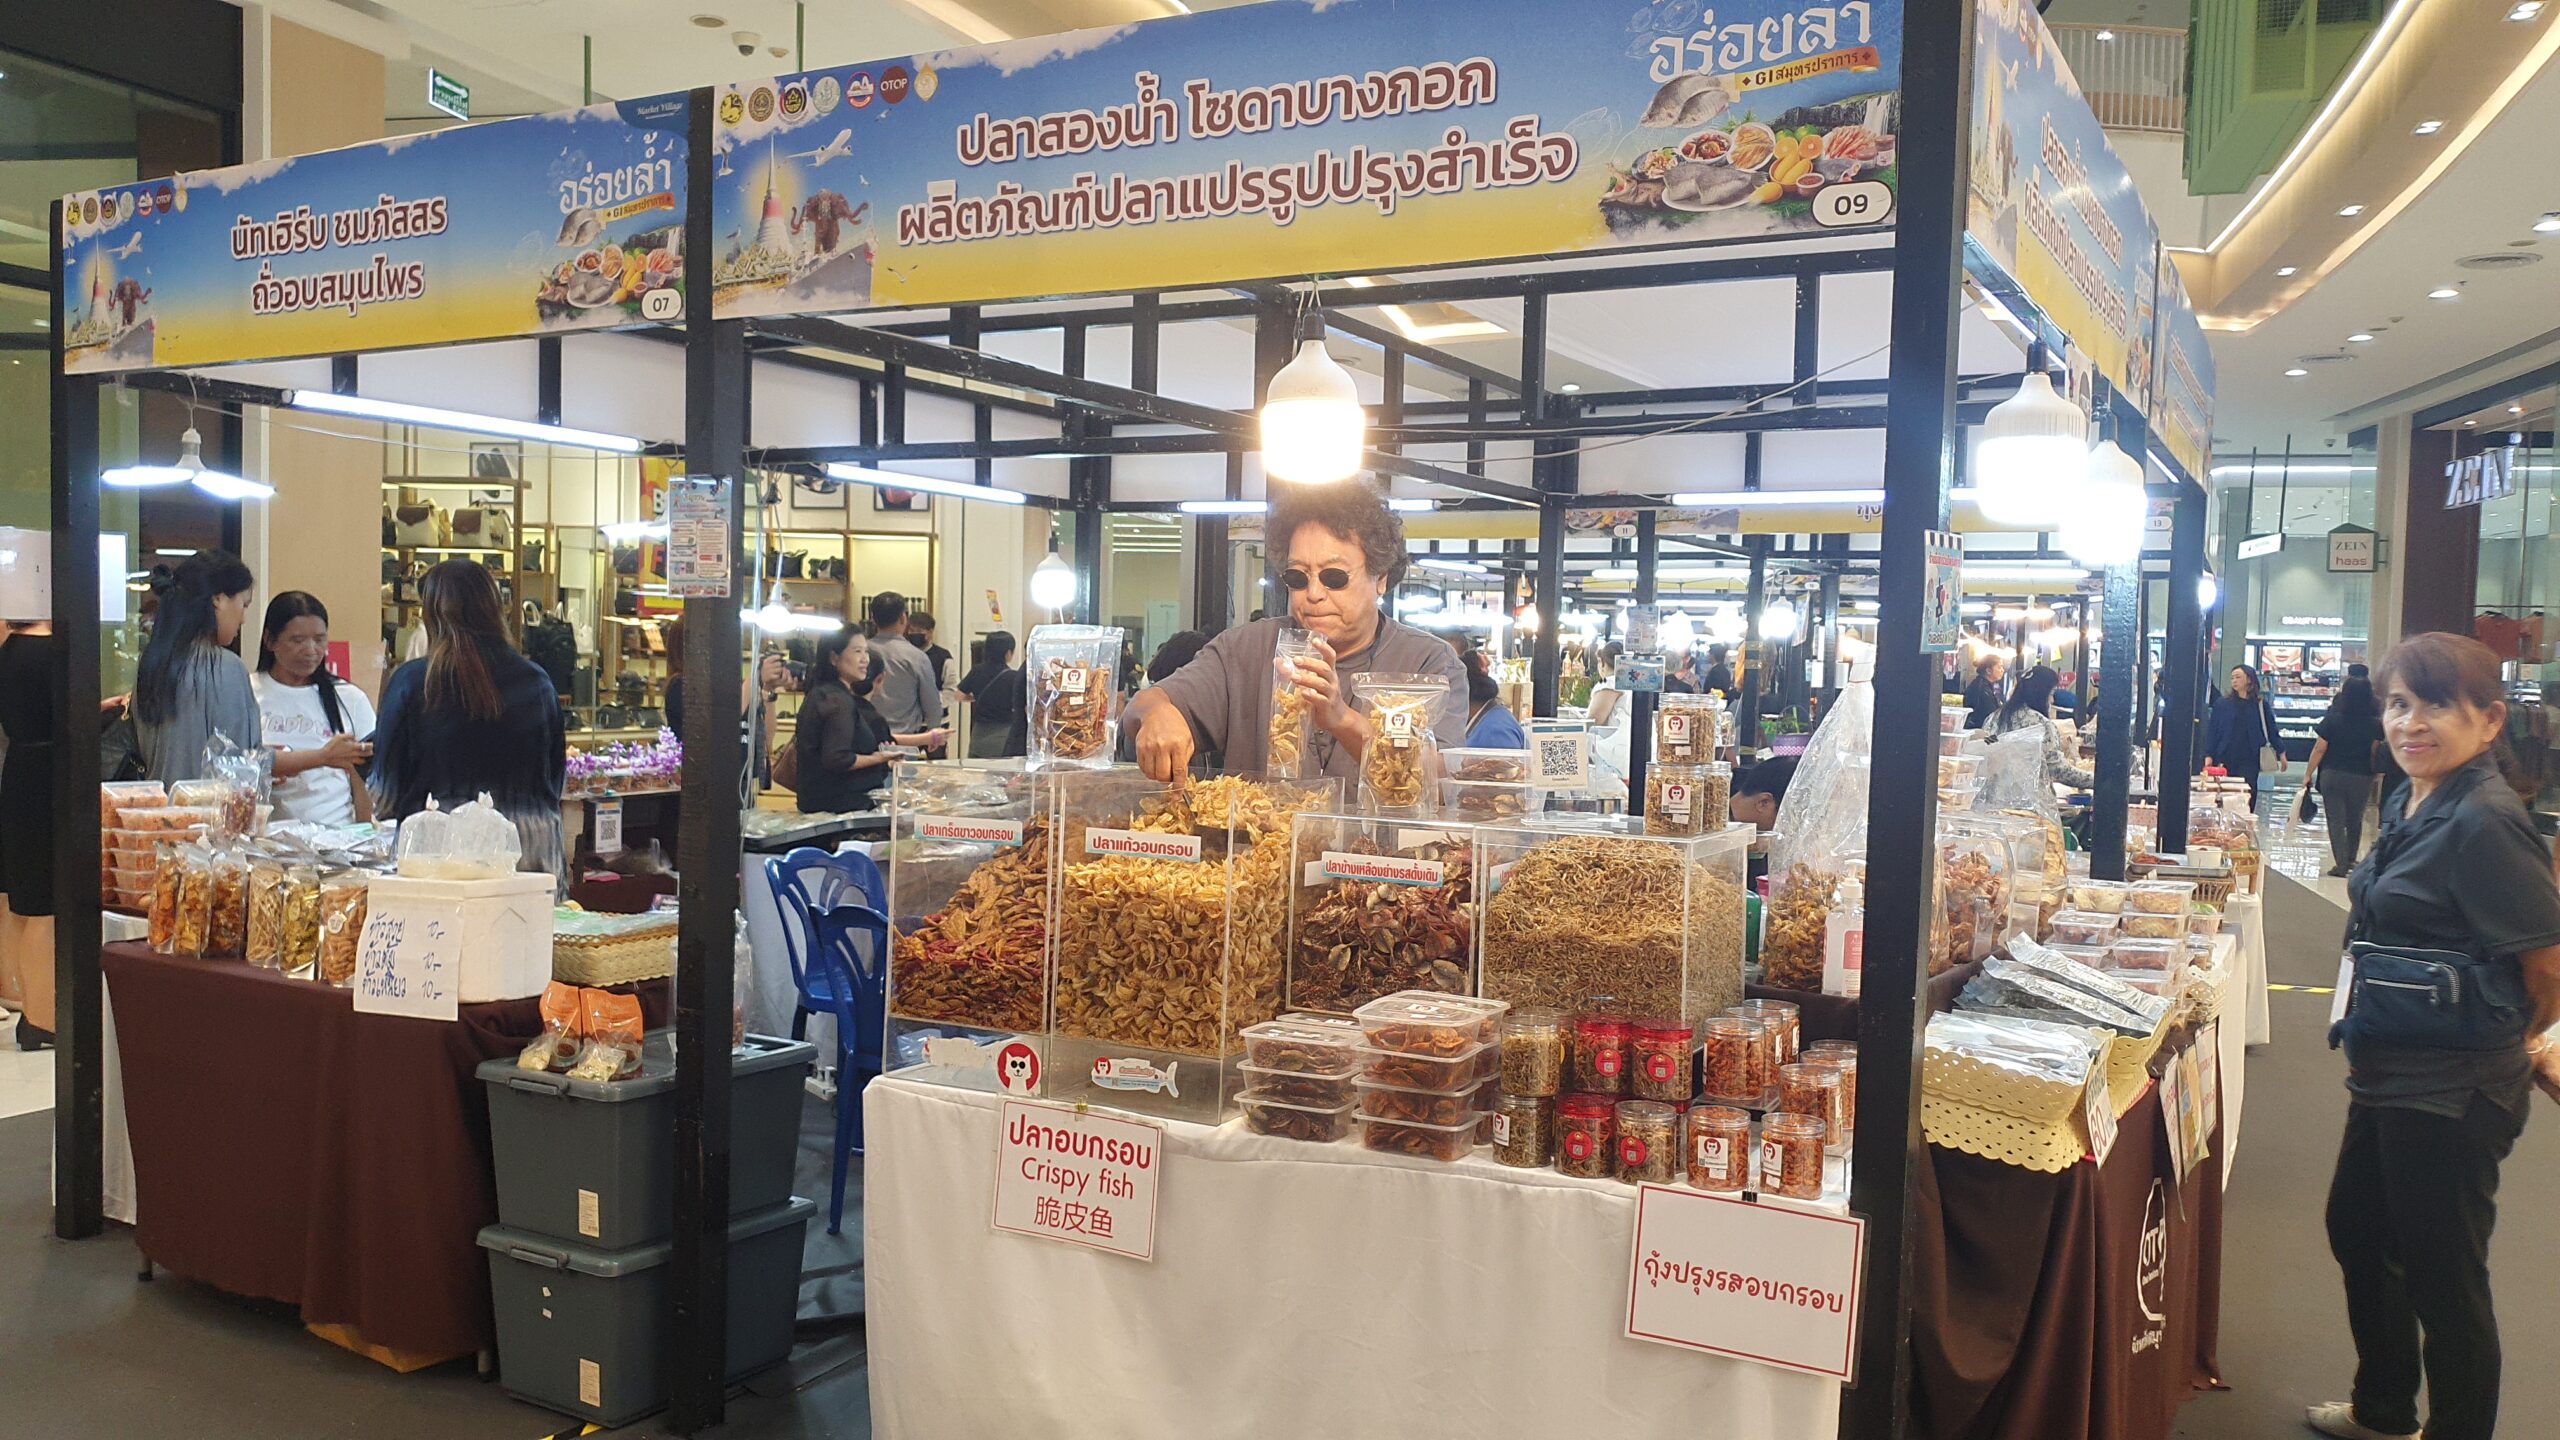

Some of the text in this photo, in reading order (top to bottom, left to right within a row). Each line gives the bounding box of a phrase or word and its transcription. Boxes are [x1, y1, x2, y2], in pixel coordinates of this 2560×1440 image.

[880, 78, 908, 92] OTOP
[958, 62, 1494, 163] ปลาสองน้ำ โซดาบางกอก
[560, 130, 671, 214] อร่อยล้ำ
[900, 116, 1577, 242] ผลิตภัณฑ์ปลาแปรรูปปรุงสำเร็จ
[231, 195, 448, 257] นัทเฮิร์บ ชมภัสสร
[1833, 193, 1869, 217] 09
[252, 256, 424, 315] ถั่วอบสมุนไพร
[652, 297, 670, 312] 07
[2335, 541, 2367, 551] ZEIN
[2335, 556, 2367, 566] haas
[922, 821, 1014, 841] ปลาเกร็ดขาวอบกรอบ
[1092, 833, 1193, 858] ปลาแก้วอบกรอบ
[1325, 859, 1439, 883] ปลาข้างเหลืองย่างรสดั้งเดิม
[1008, 1113, 1152, 1170] ปลาอบกรอบ
[1021, 1156, 1134, 1200] Crispy fish
[1033, 1195, 1114, 1239] 脆皮鱼
[1643, 1249, 1845, 1313] กุ้งปรุงรสอบกรอบ
